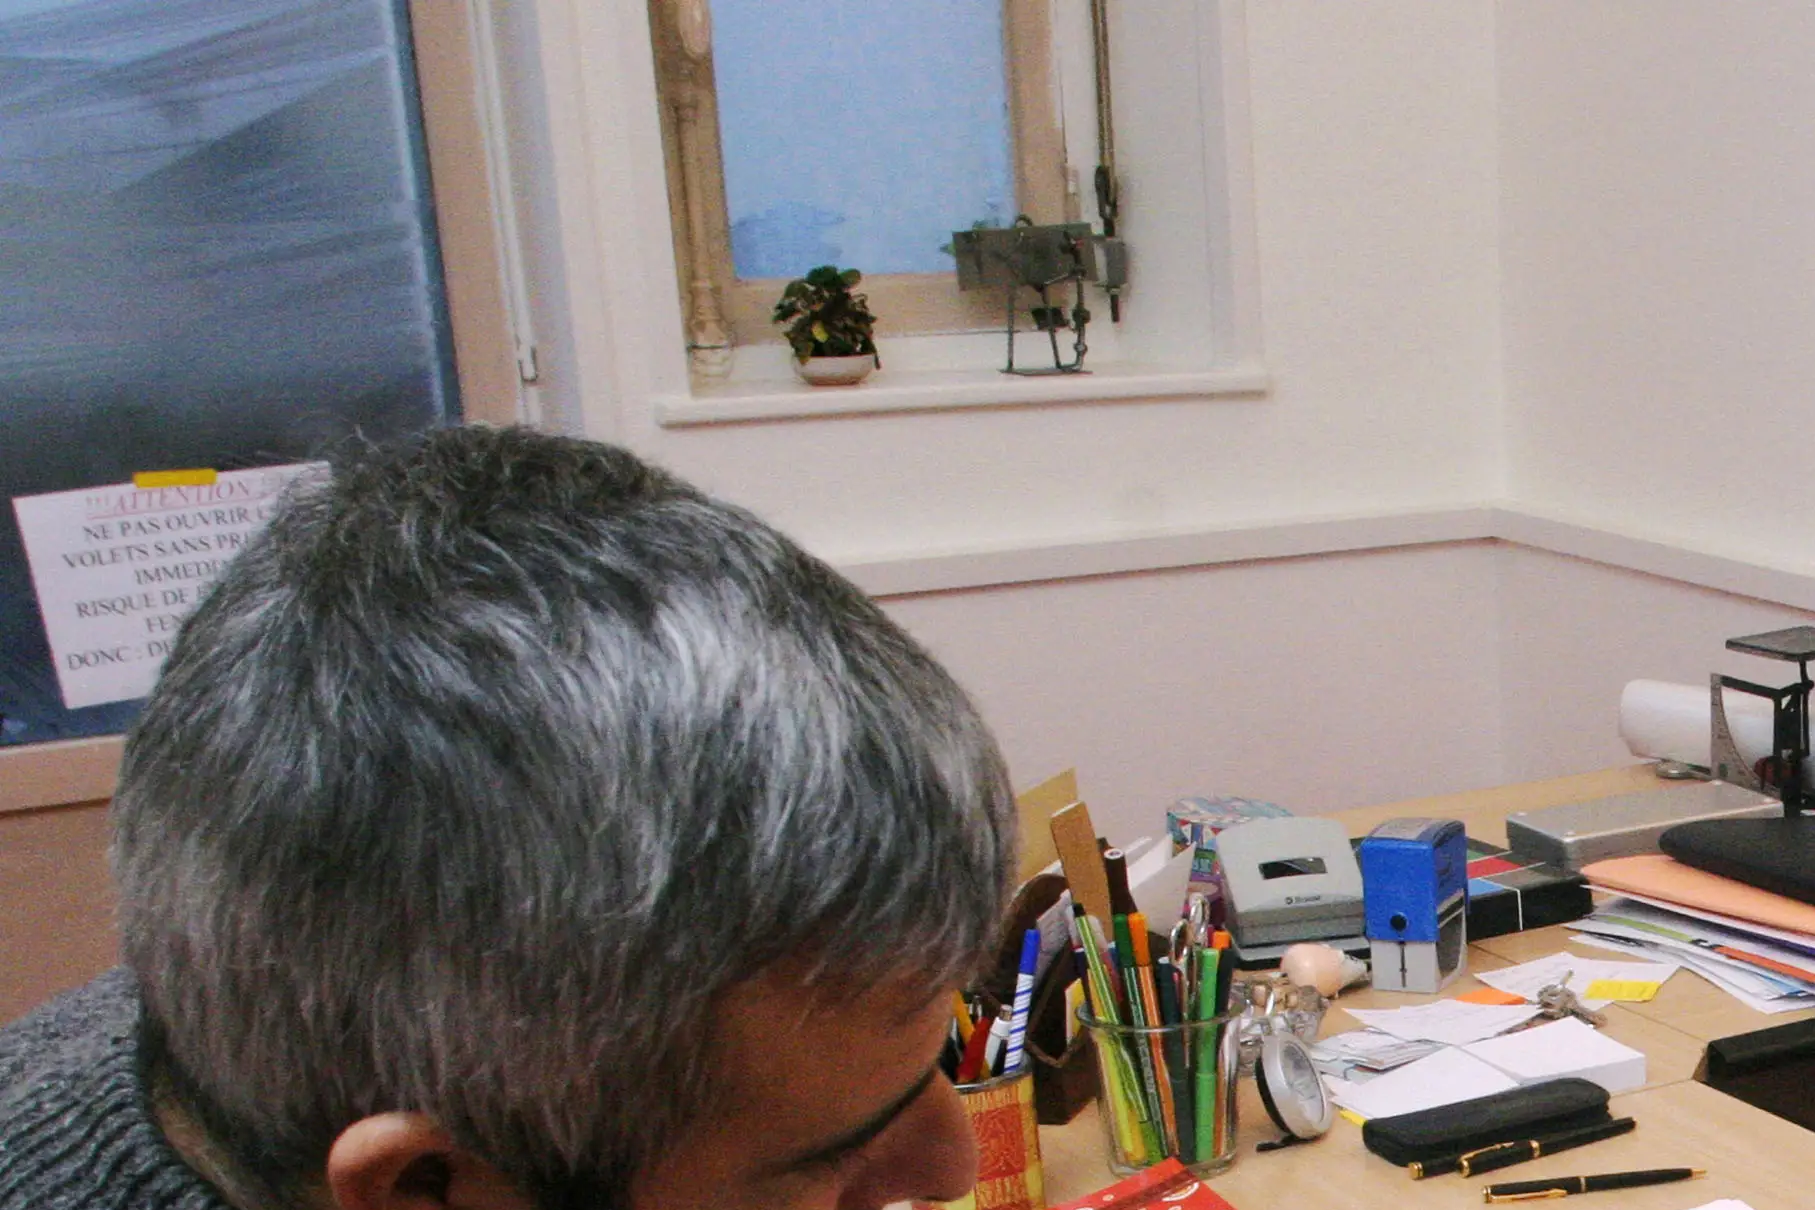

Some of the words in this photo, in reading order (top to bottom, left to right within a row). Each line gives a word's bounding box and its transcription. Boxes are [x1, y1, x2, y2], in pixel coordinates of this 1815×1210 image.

[82, 524, 113, 542] NE
[119, 516, 161, 538] PAS
[164, 506, 250, 531] OUVRIR
[62, 544, 150, 569] VOLETS
[153, 533, 211, 556] SANS
[75, 592, 158, 619] RISQUE
[160, 587, 189, 607] DE
[66, 645, 131, 671] DONC
